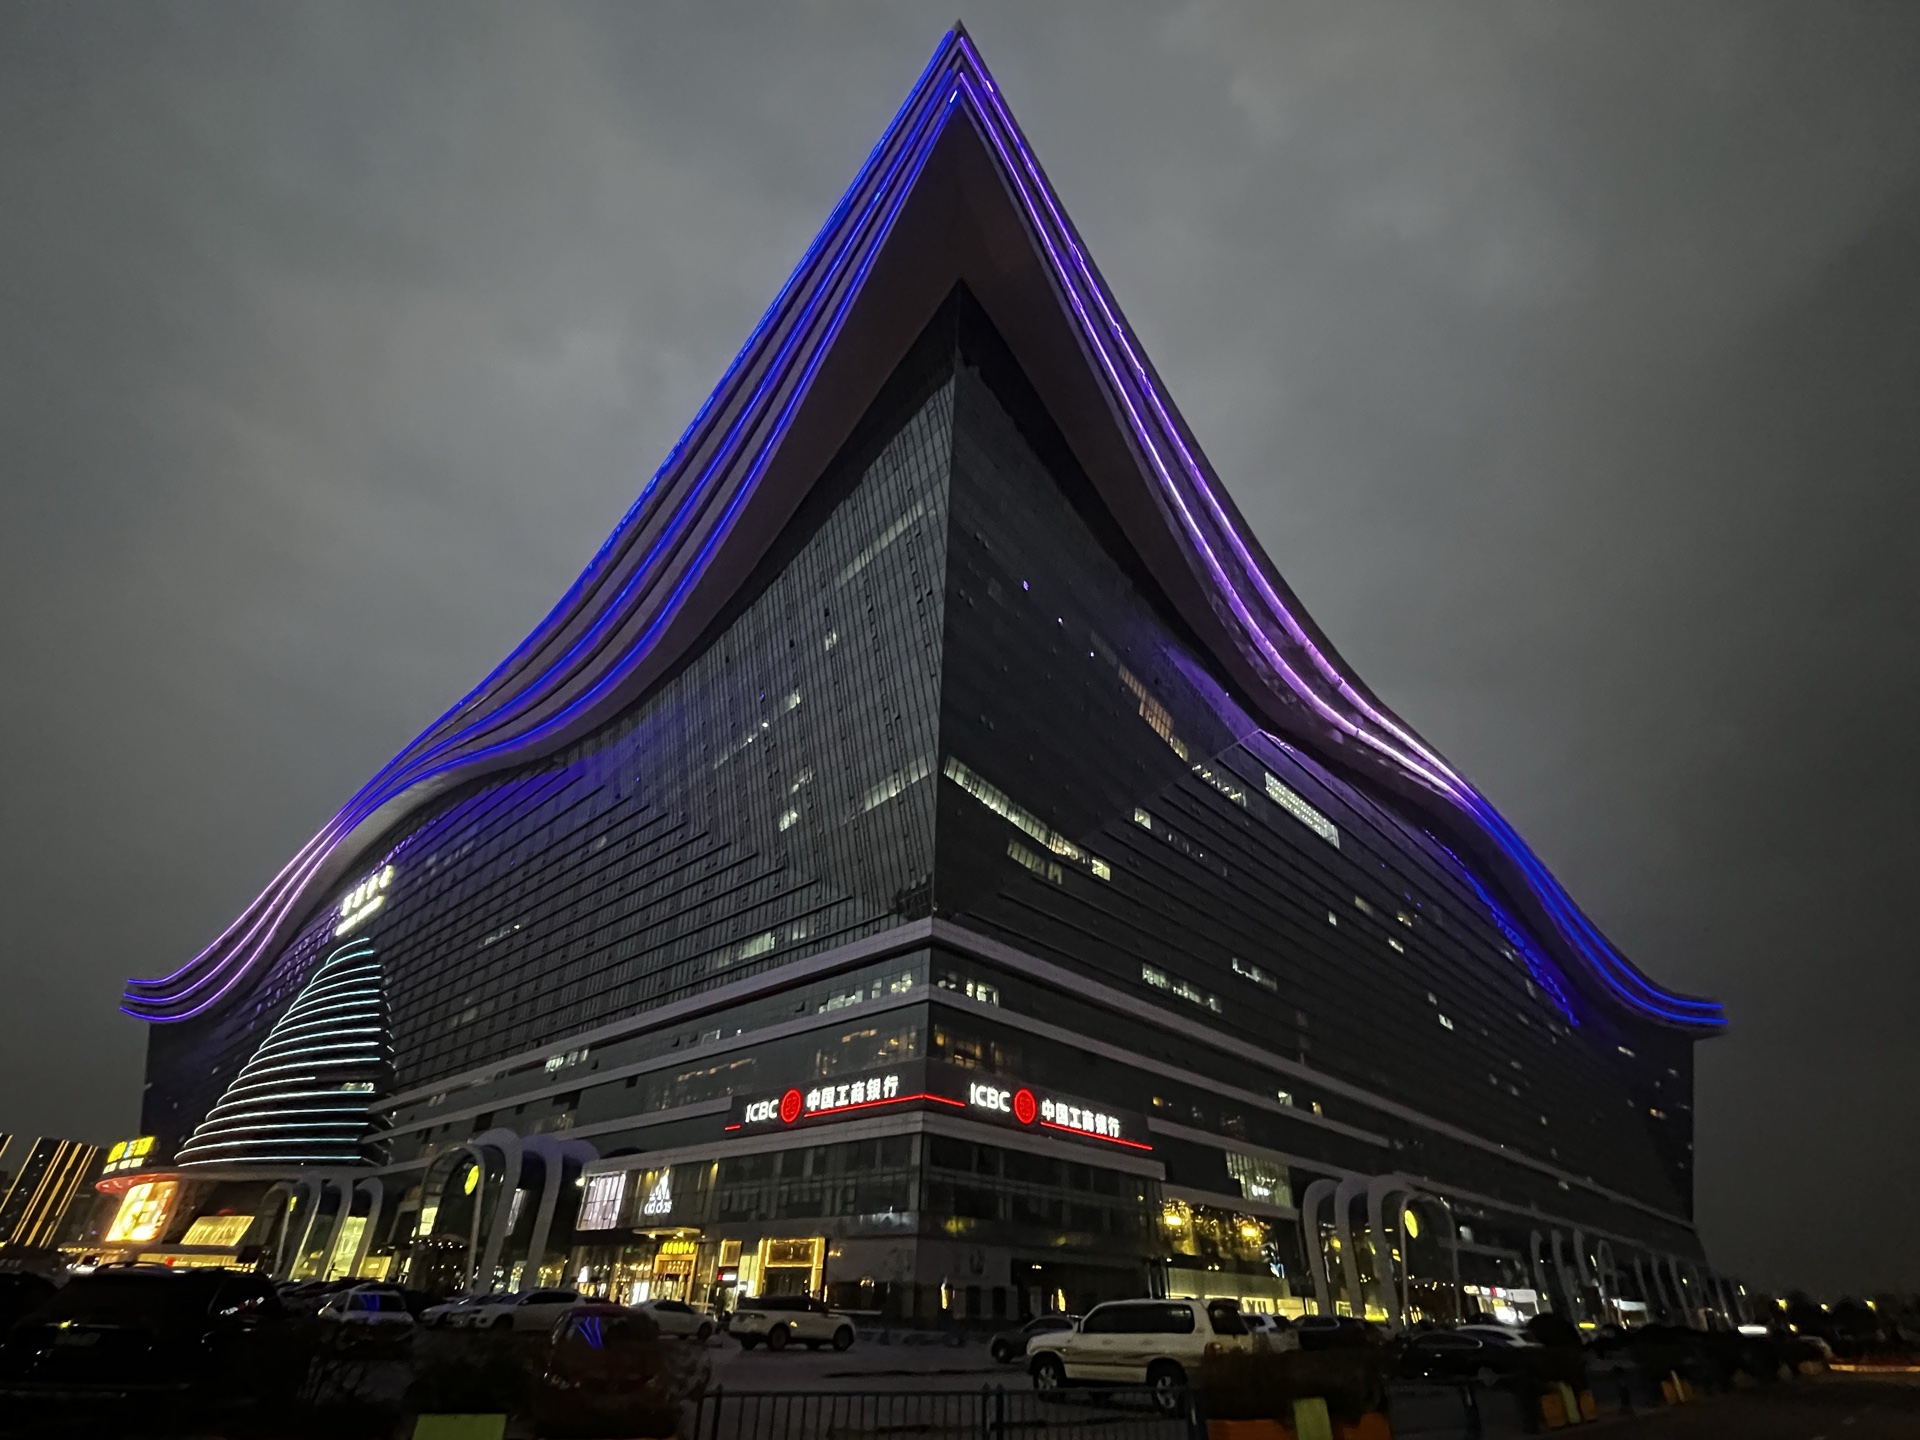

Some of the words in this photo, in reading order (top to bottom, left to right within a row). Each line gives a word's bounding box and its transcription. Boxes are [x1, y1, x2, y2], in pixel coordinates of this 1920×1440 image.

[745, 1099, 779, 1123] ICBC
[806, 1075, 899, 1111] 中国工商银行
[970, 1083, 1011, 1112] ICBC
[1041, 1099, 1120, 1138] 中国工商银行
